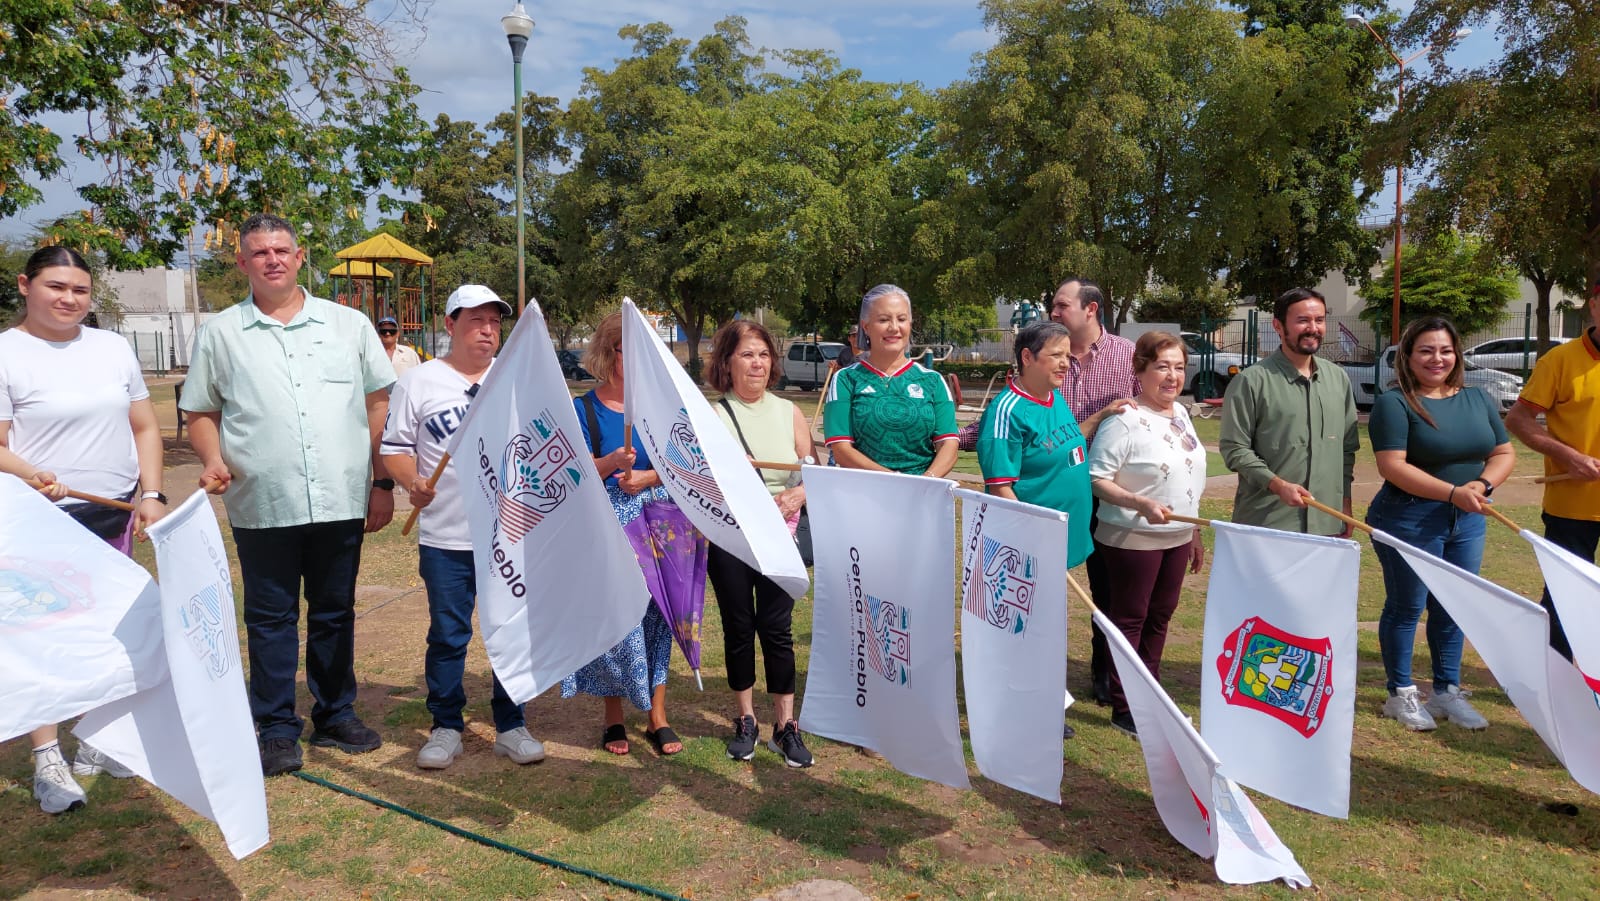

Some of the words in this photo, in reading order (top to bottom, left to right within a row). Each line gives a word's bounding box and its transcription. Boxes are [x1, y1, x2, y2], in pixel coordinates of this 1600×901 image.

[1040, 422, 1082, 455] MEXIC
[688, 488, 740, 530] Pueb
[970, 502, 988, 552] erca
[849, 546, 864, 614] Cerca
[856, 630, 868, 708] Pueblo
